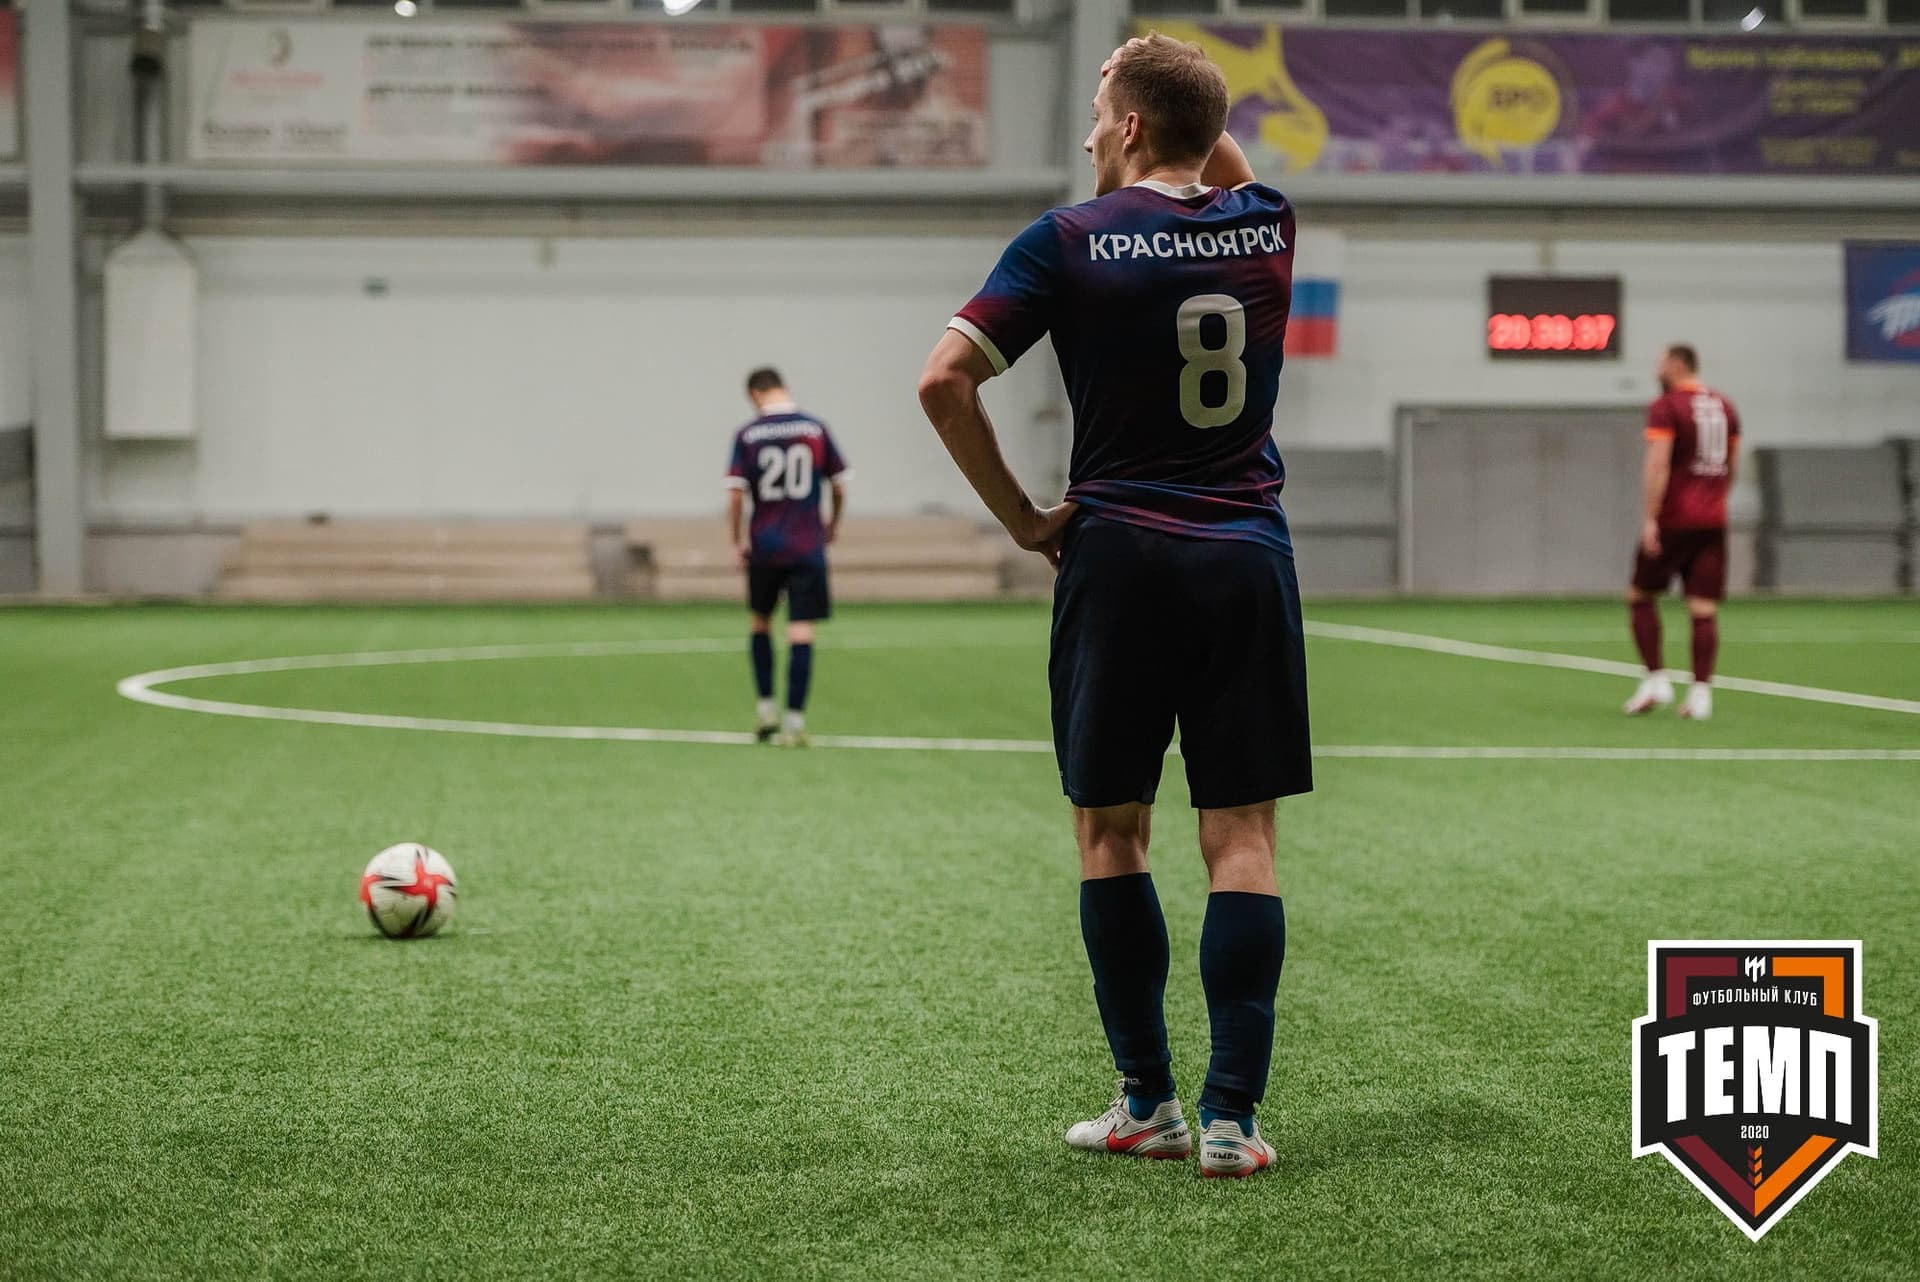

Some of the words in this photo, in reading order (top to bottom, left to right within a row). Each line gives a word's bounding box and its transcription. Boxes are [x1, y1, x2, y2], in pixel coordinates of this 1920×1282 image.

[1088, 222, 1288, 261] КРАСНОЯРСК
[1176, 293, 1247, 429] 8
[757, 442, 814, 501] 20
[1206, 1151, 1241, 1161] TIEMPO
